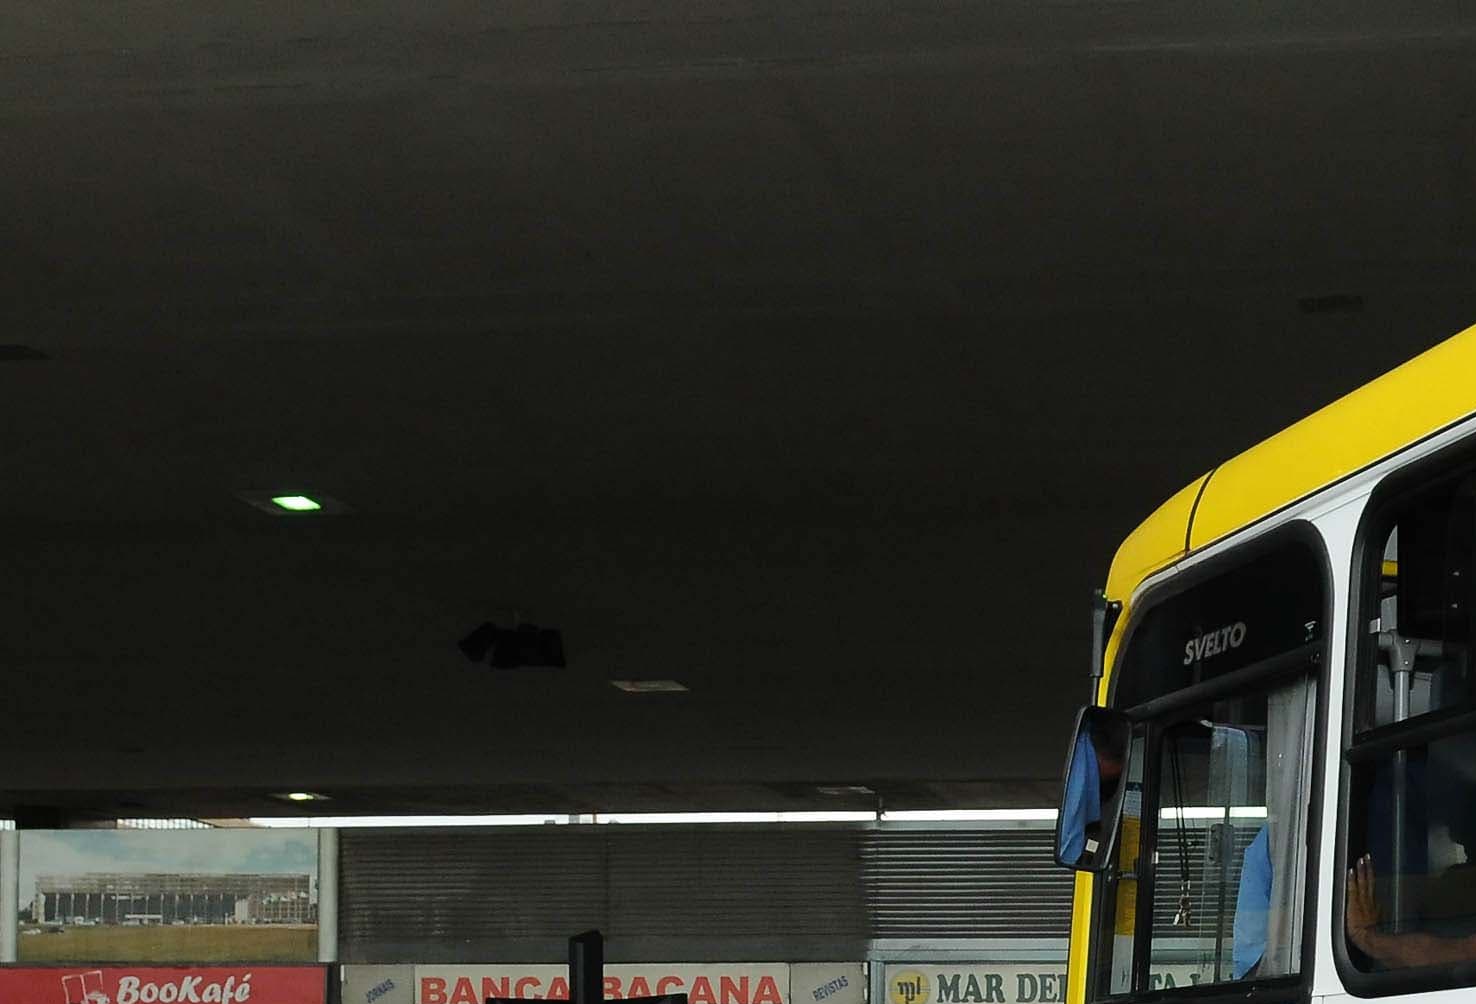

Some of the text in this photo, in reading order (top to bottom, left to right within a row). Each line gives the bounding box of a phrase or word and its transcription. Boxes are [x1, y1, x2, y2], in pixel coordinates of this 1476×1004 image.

[1183, 621, 1247, 665] SVELTO
[812, 975, 849, 1002] REVISTAS
[936, 973, 1005, 1004] MAR
